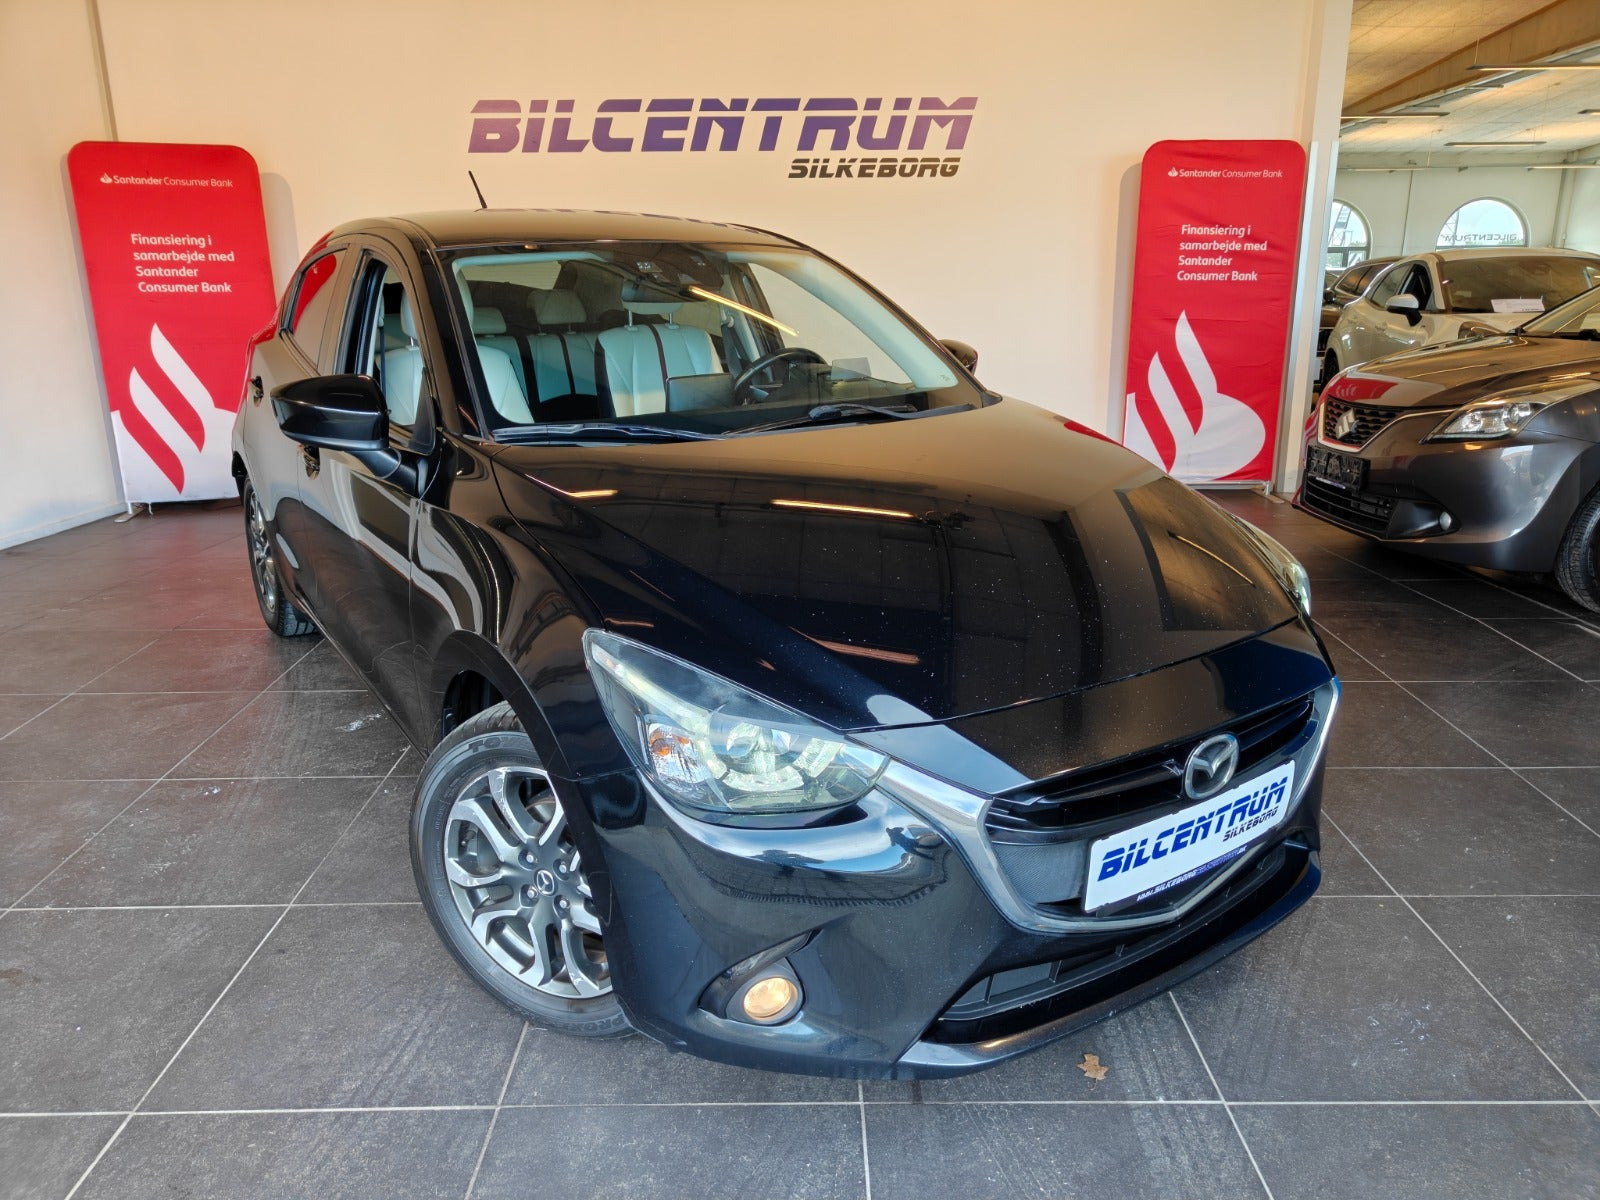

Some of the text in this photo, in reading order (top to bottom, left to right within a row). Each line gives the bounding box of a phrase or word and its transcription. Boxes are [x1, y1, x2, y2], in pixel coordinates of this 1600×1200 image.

[467, 97, 978, 153] BILCENTRUM
[788, 157, 961, 179] SILKEBORG
[1179, 169, 1283, 178] Santander Consumer Bank
[113, 175, 233, 188] Santander Consumer Bank
[1181, 224, 1251, 238] Finansiering i
[131, 233, 212, 248] Finansiering i
[1179, 240, 1268, 253] samarbejde med
[133, 251, 235, 263] samarbejde med
[1178, 255, 1233, 266] Santander
[135, 265, 198, 277] Santander
[1177, 270, 1258, 281] Consumer Bank
[138, 281, 232, 293] Consumer Bank
[1097, 776, 1288, 882] BILCENTRUM
[1222, 806, 1279, 842] SILKEBORG
